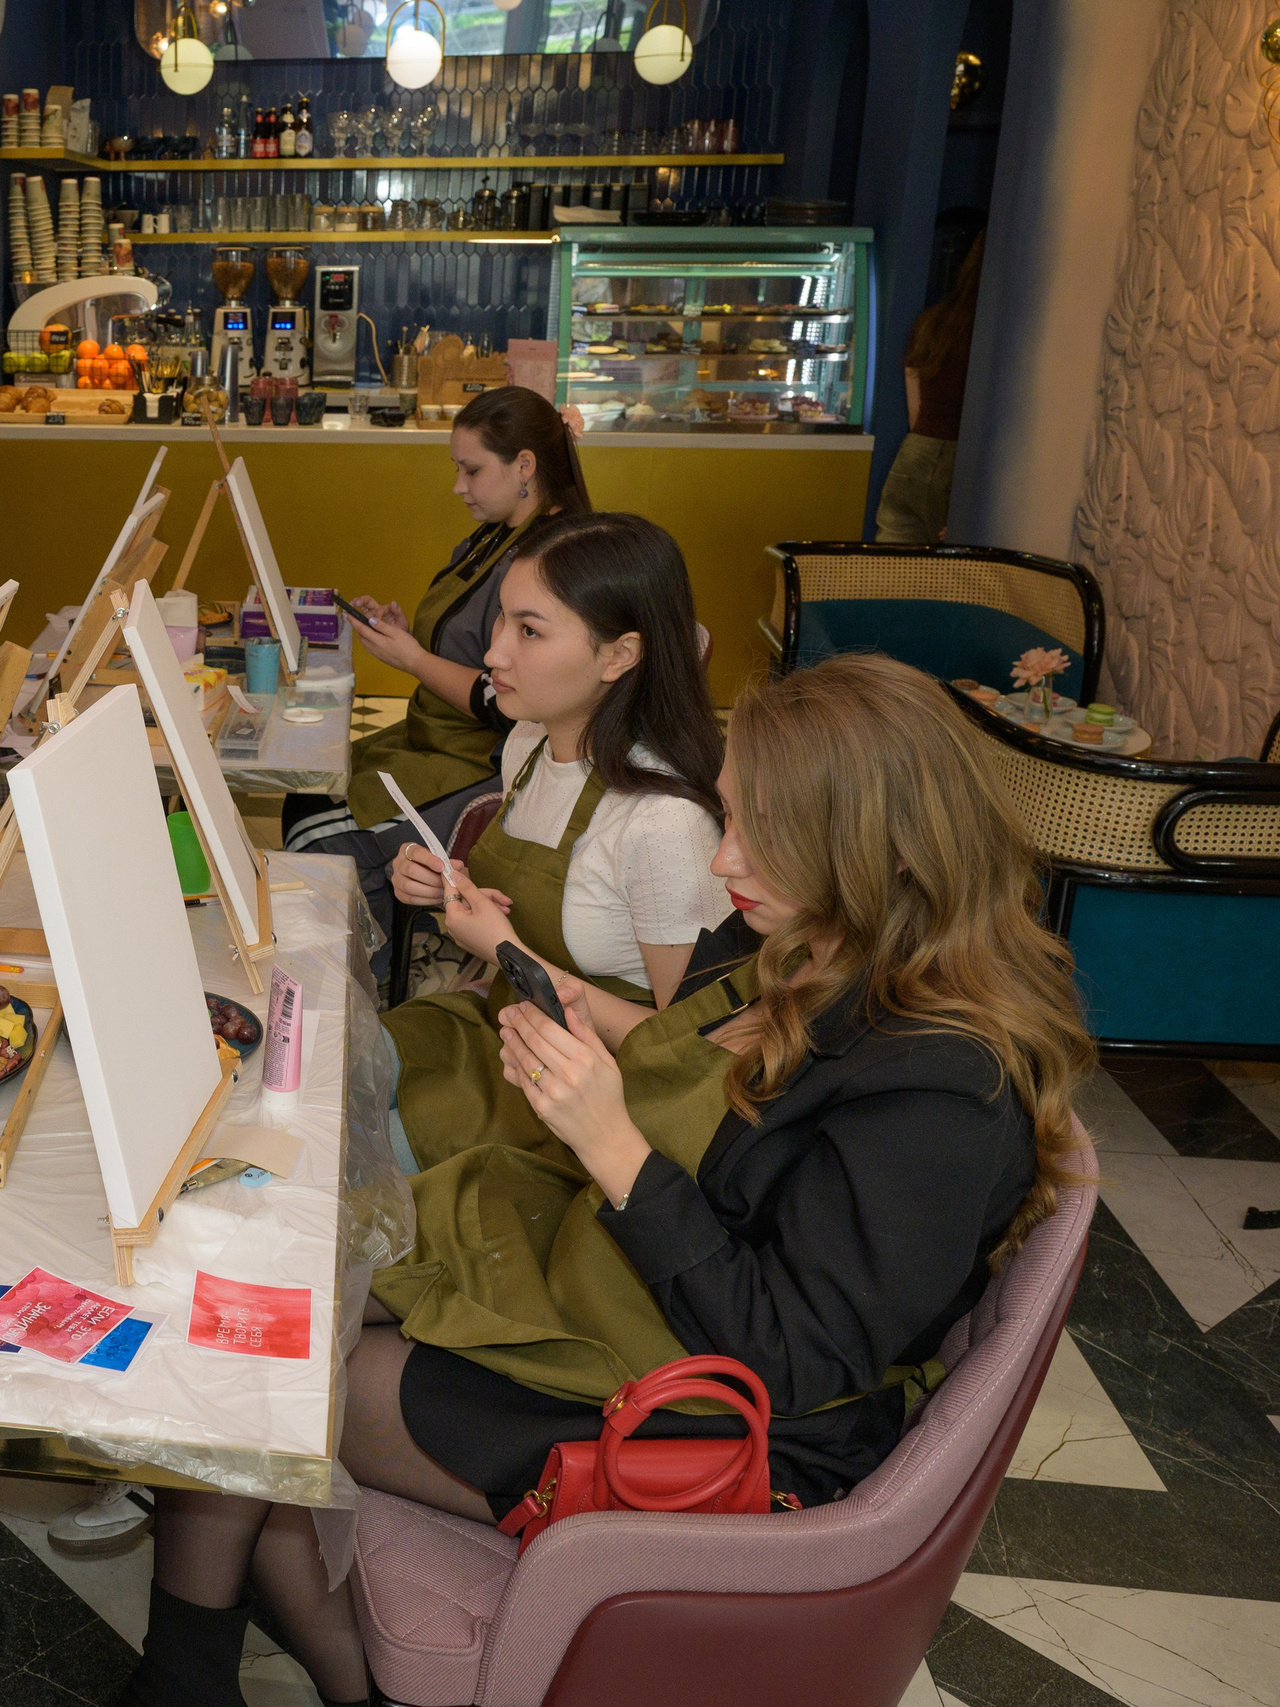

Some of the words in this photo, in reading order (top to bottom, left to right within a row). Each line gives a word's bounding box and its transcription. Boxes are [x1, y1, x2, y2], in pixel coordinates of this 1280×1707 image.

[20, 1301, 52, 1331] ЗНАЧИТ
[88, 1305, 116, 1326] ЕСЛИ
[233, 1307, 250, 1345] ТВОРИТЬ
[71, 1326, 92, 1341] ЭТО
[249, 1326, 263, 1348] СЕБЯ
